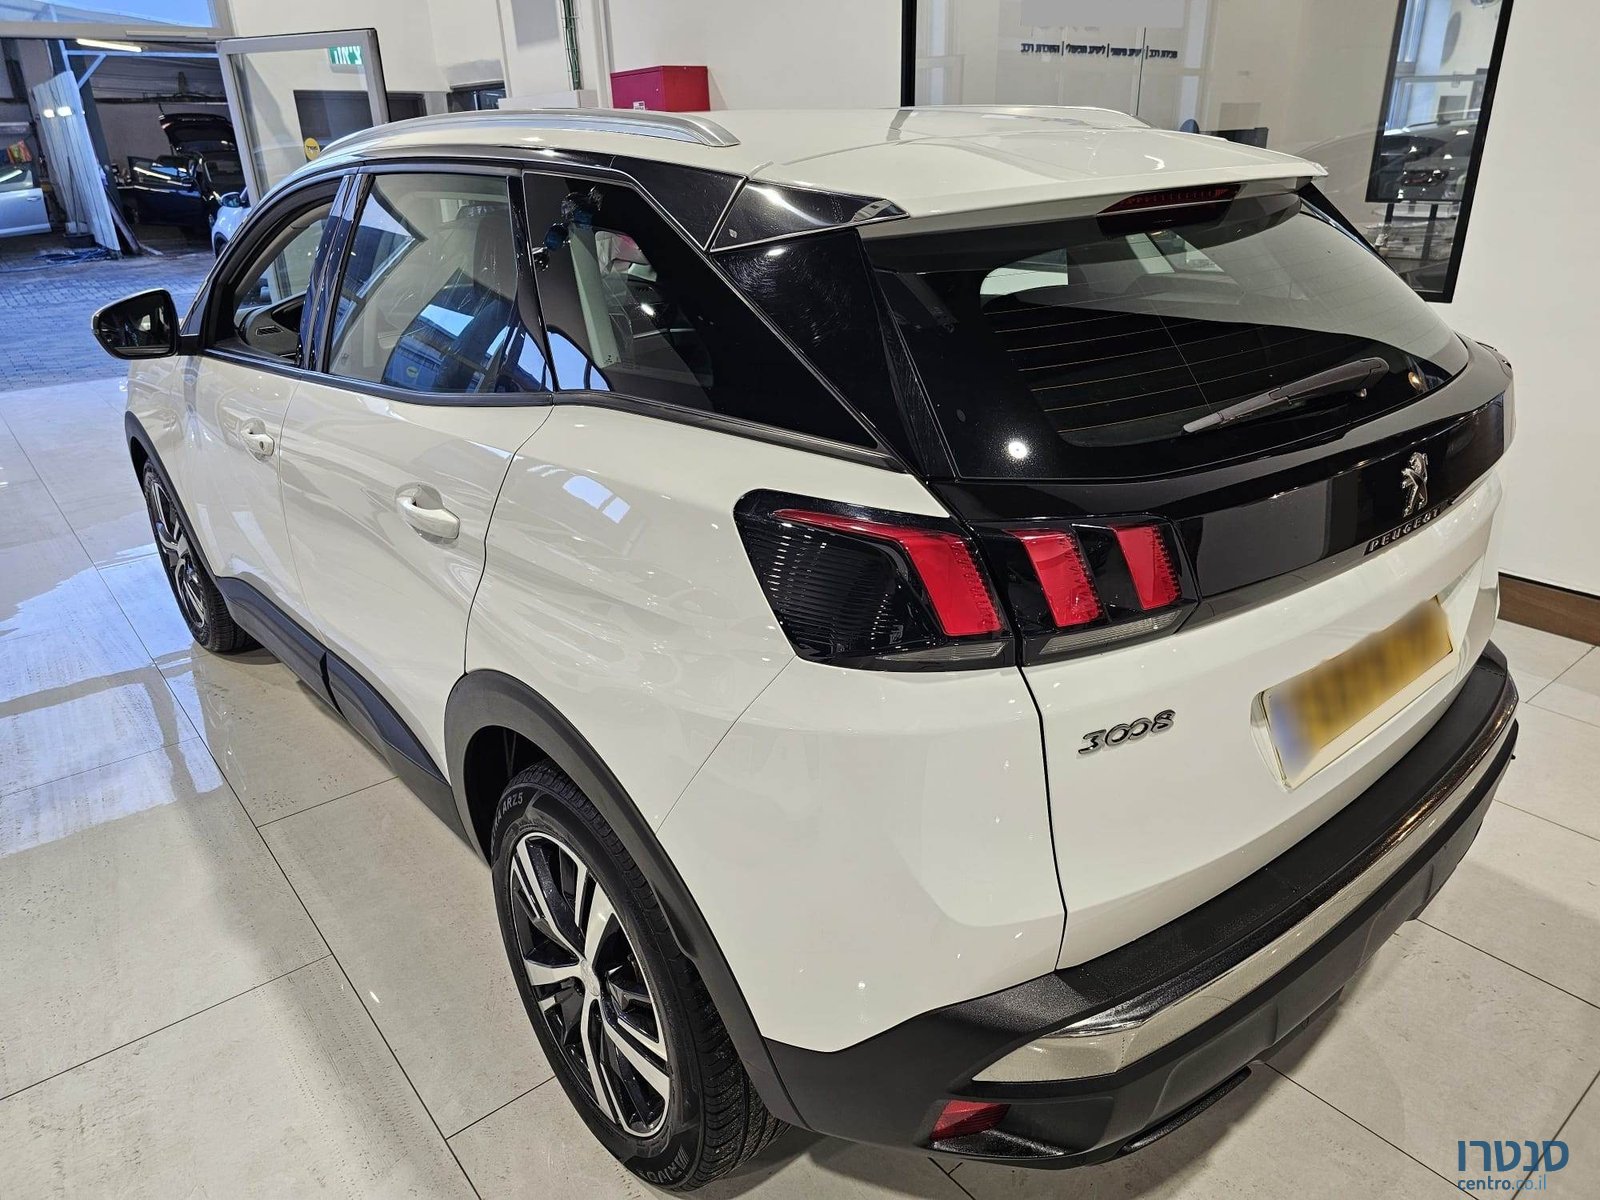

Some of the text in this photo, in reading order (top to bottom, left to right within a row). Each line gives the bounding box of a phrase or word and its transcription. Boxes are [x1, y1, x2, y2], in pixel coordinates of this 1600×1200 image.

[1368, 508, 1438, 552] PEUGEOT
[1078, 708, 1176, 755] 3008
[502, 791, 524, 815] ARZ5
